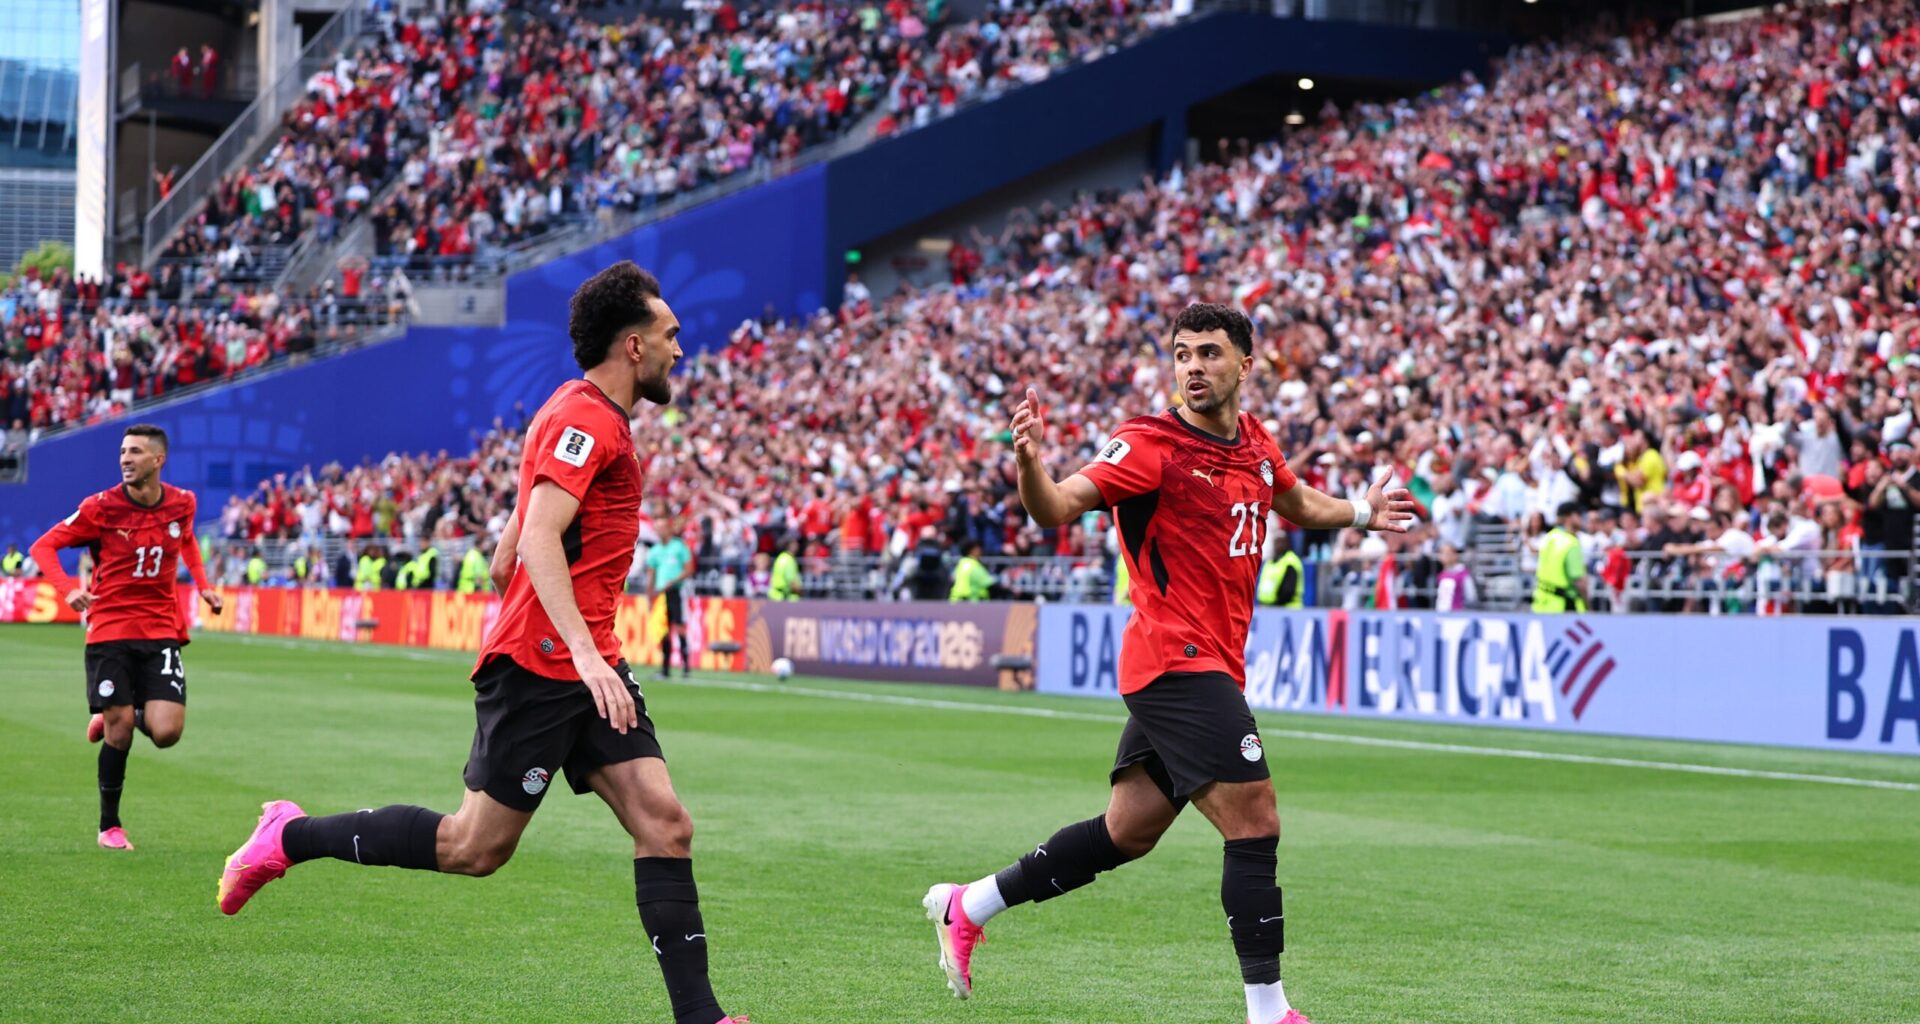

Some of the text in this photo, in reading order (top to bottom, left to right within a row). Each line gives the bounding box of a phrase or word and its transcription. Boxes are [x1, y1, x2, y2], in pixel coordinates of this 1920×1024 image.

[1229, 501, 1260, 557] 21
[132, 545, 164, 578] 13
[784, 617, 819, 660] FIFA
[160, 647, 185, 679] 13
